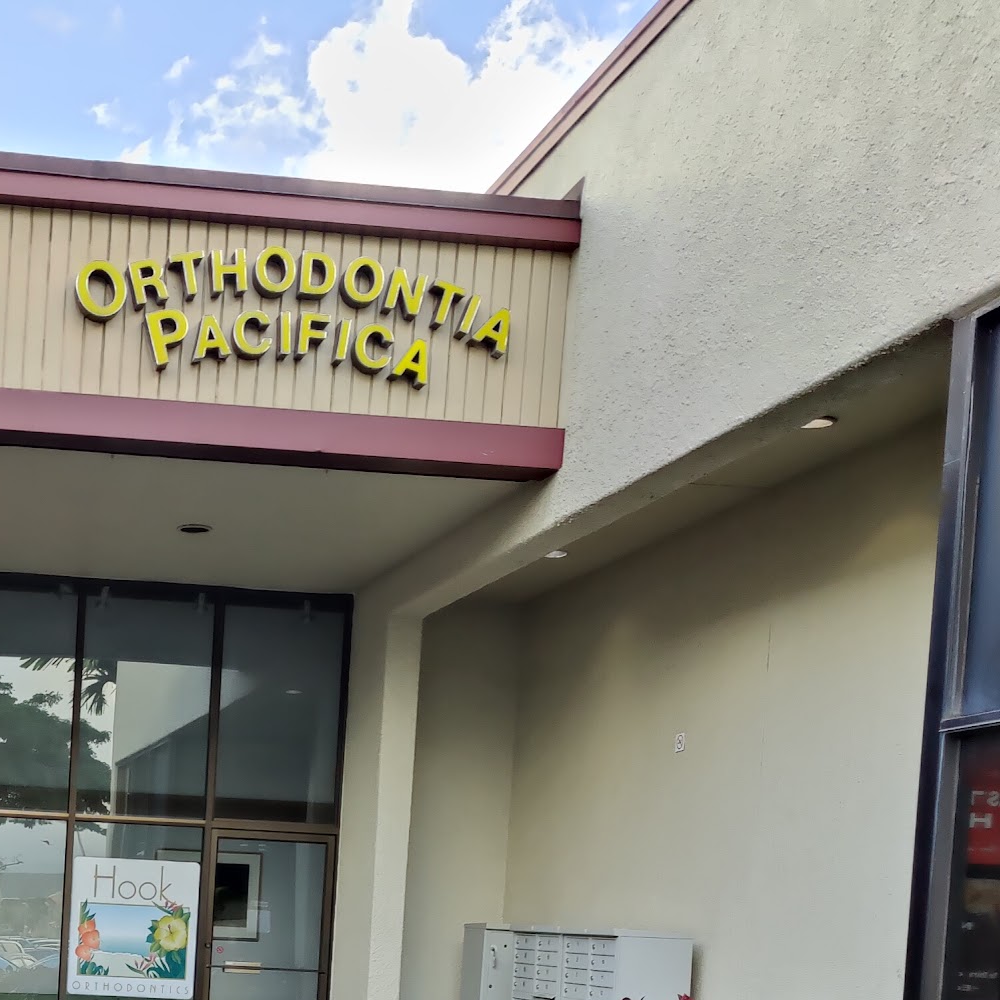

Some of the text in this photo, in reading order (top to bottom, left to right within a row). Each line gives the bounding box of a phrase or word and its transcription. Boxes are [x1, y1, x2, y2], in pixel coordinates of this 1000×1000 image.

[75, 246, 511, 359] ORTHODONTIA
[145, 309, 427, 390] PACIFICA
[94, 864, 172, 901] Hook
[72, 980, 189, 994] ORTHODONTICS
